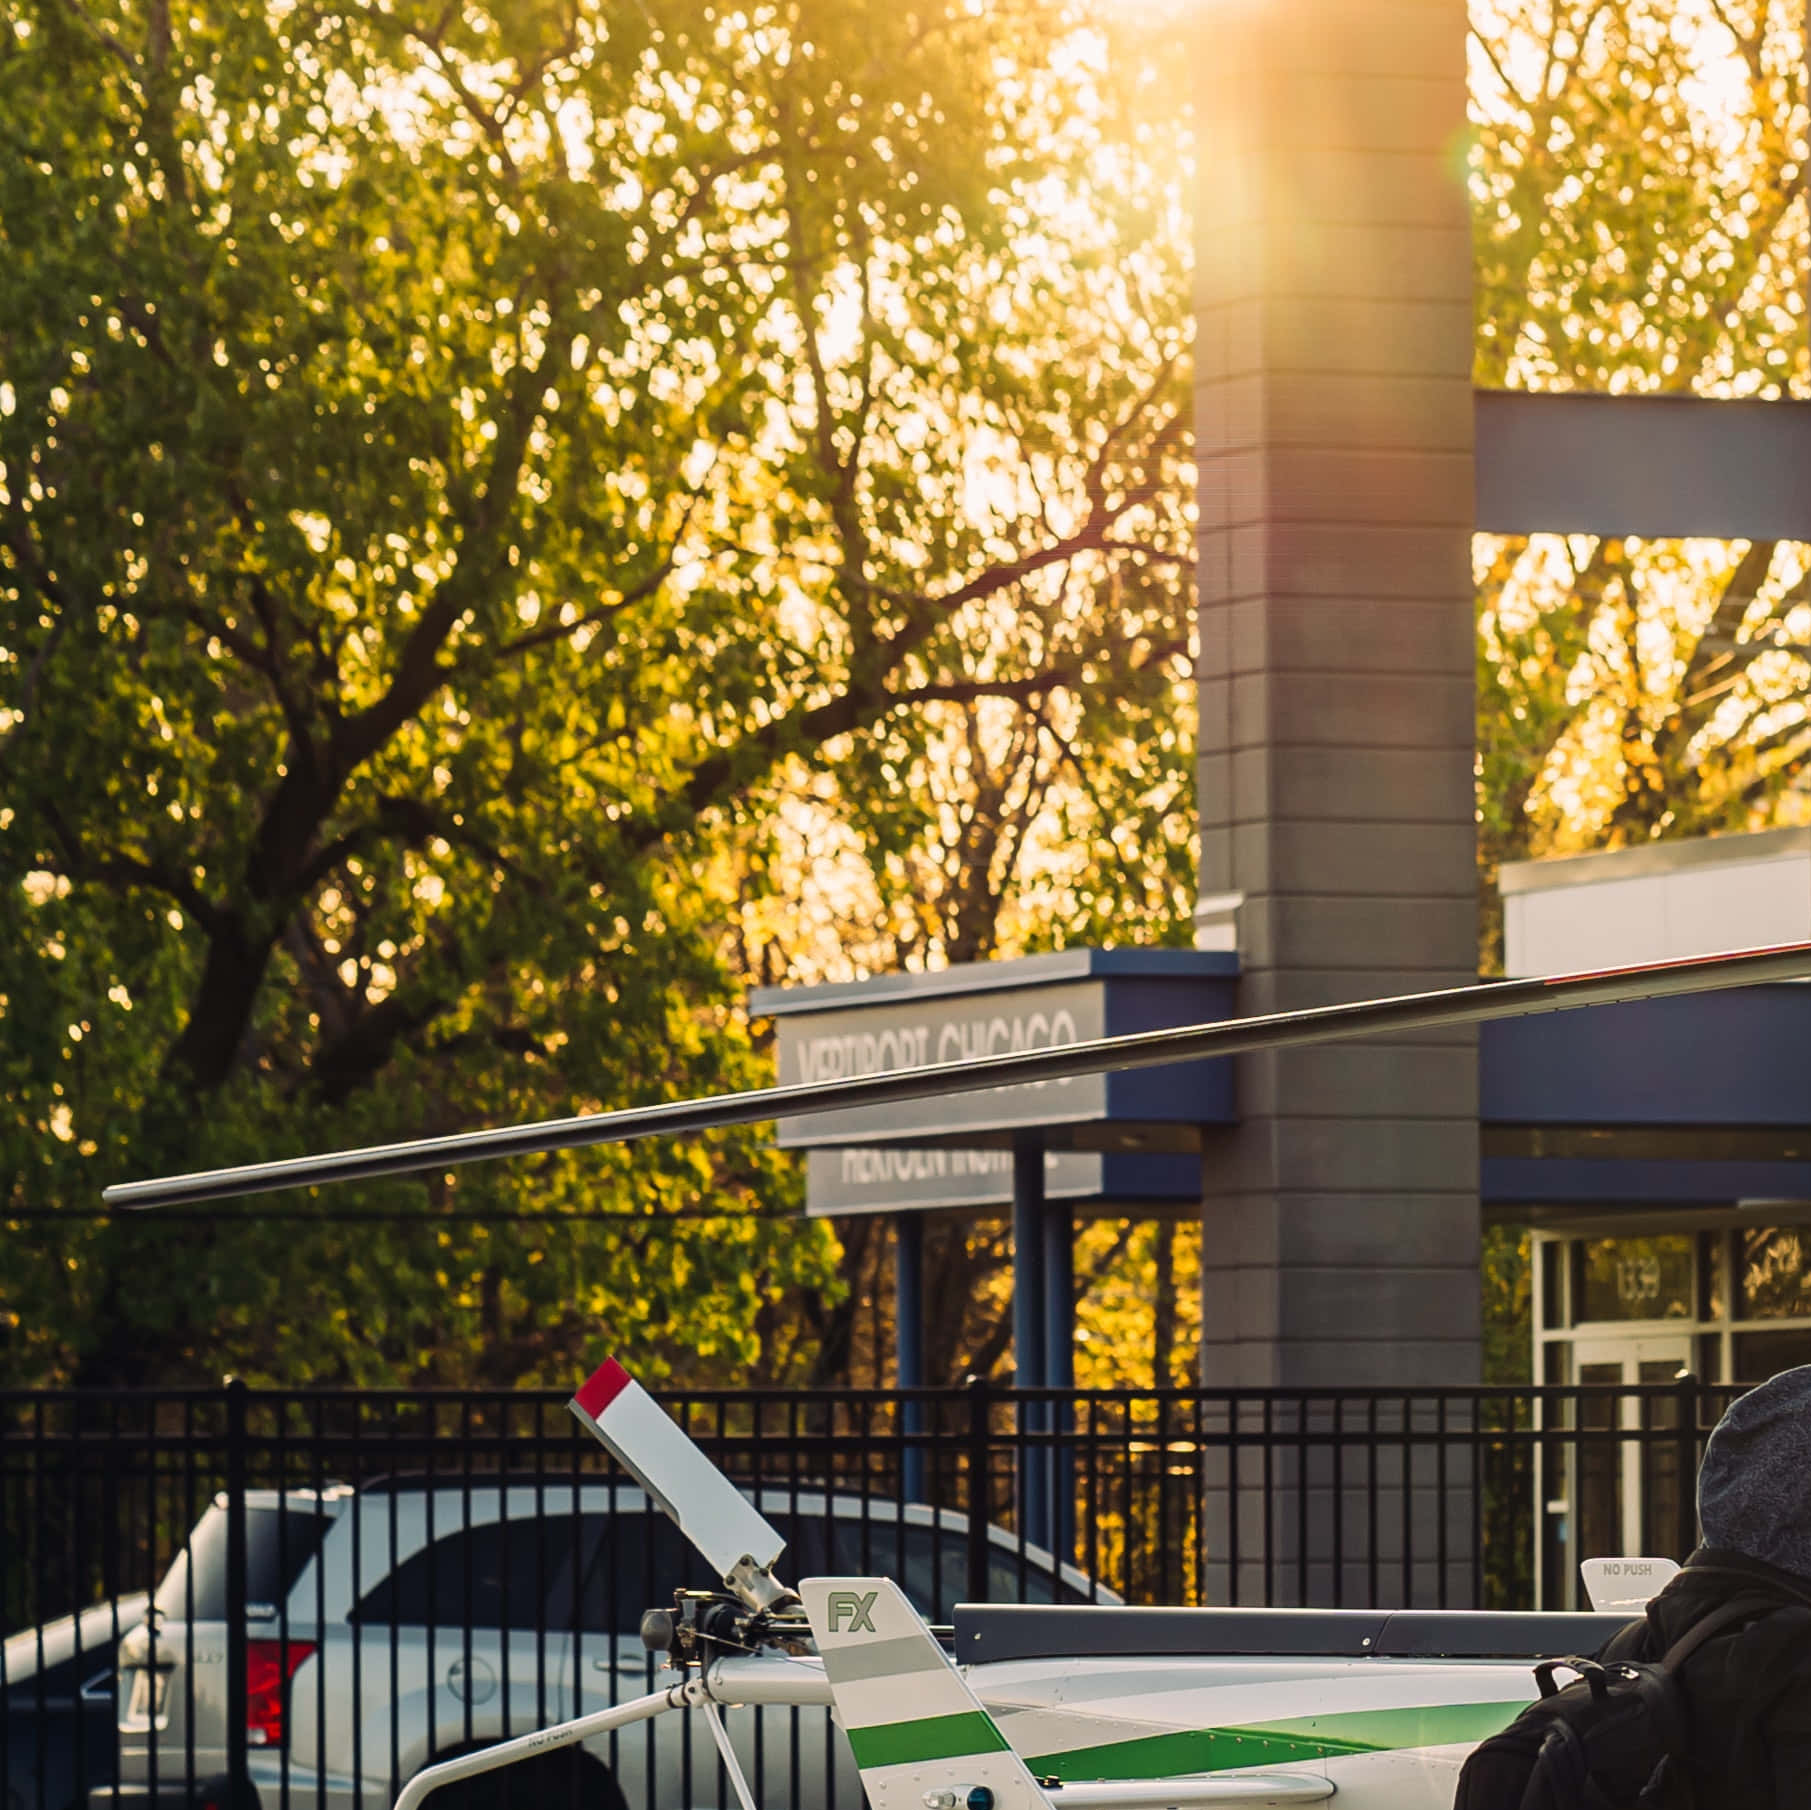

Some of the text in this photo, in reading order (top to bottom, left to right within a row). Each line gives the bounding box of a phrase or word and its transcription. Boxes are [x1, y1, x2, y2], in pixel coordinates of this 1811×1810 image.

[1603, 1563, 1652, 1576] NO PUSH
[828, 1591, 878, 1632] FX
